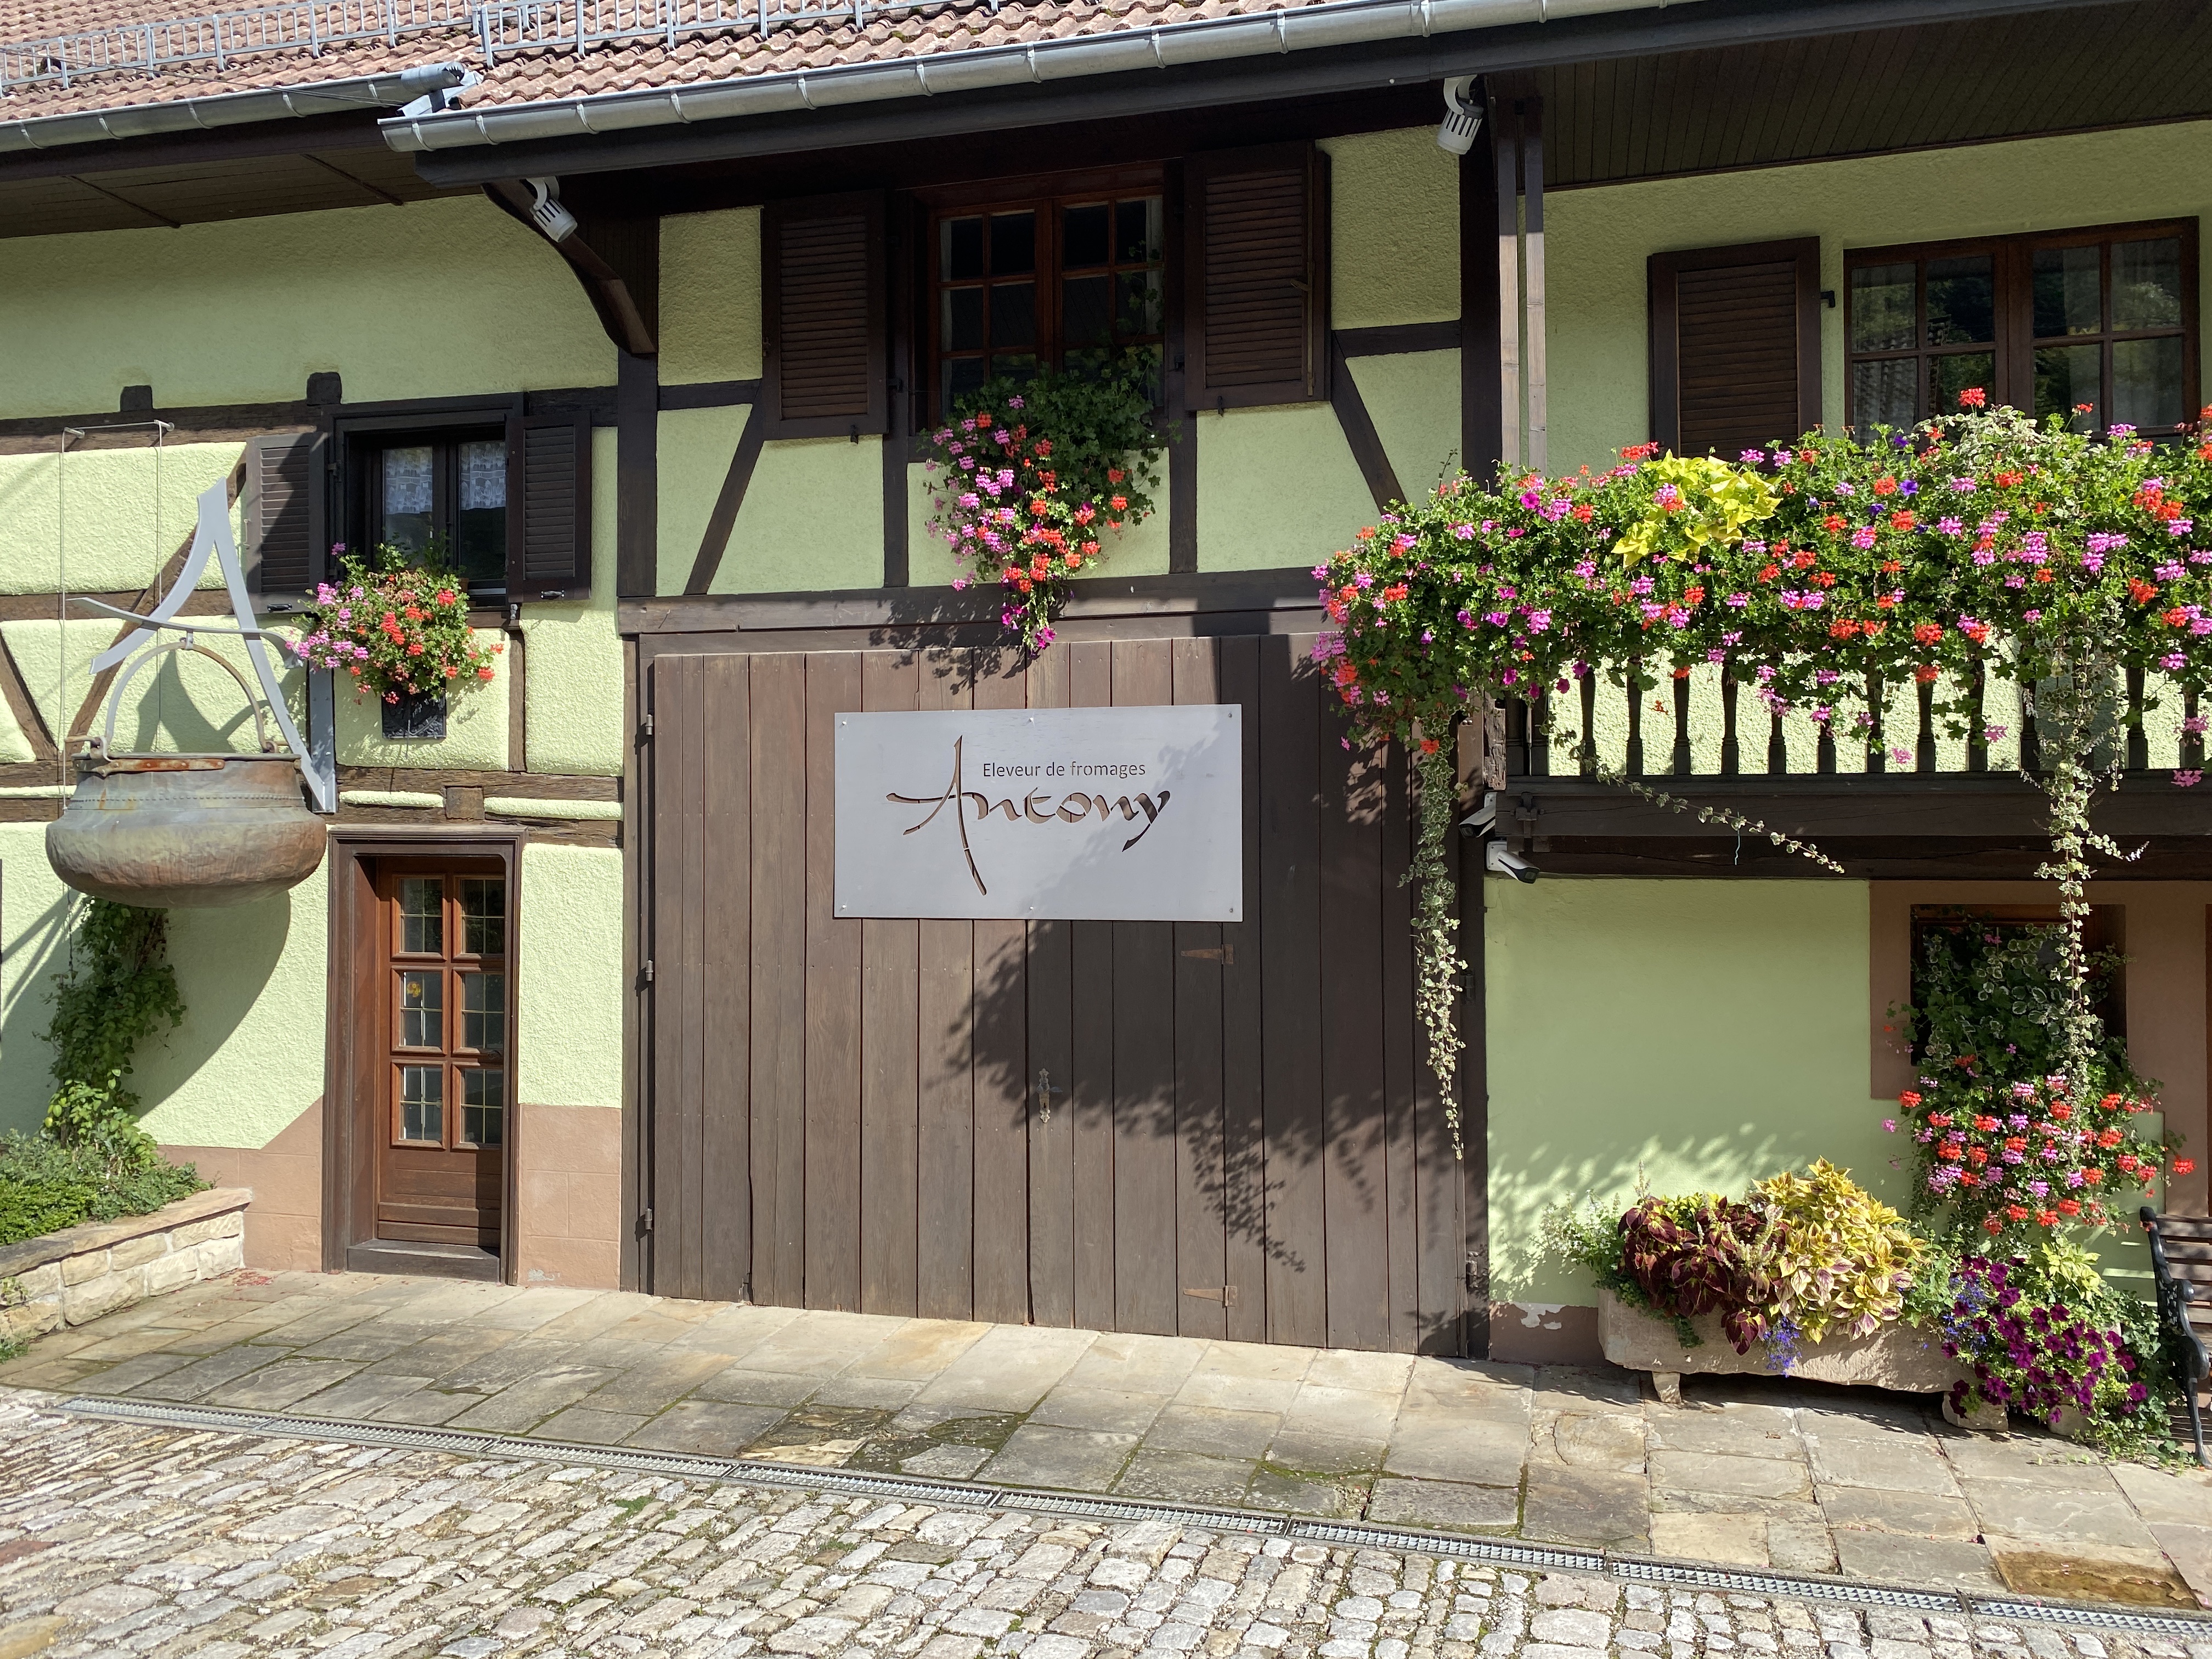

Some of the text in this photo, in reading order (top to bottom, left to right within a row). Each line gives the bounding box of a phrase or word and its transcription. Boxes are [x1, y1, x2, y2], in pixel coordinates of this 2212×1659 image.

[983, 760, 1146, 779] Eleveur de fromages
[885, 735, 1171, 896] Antony
